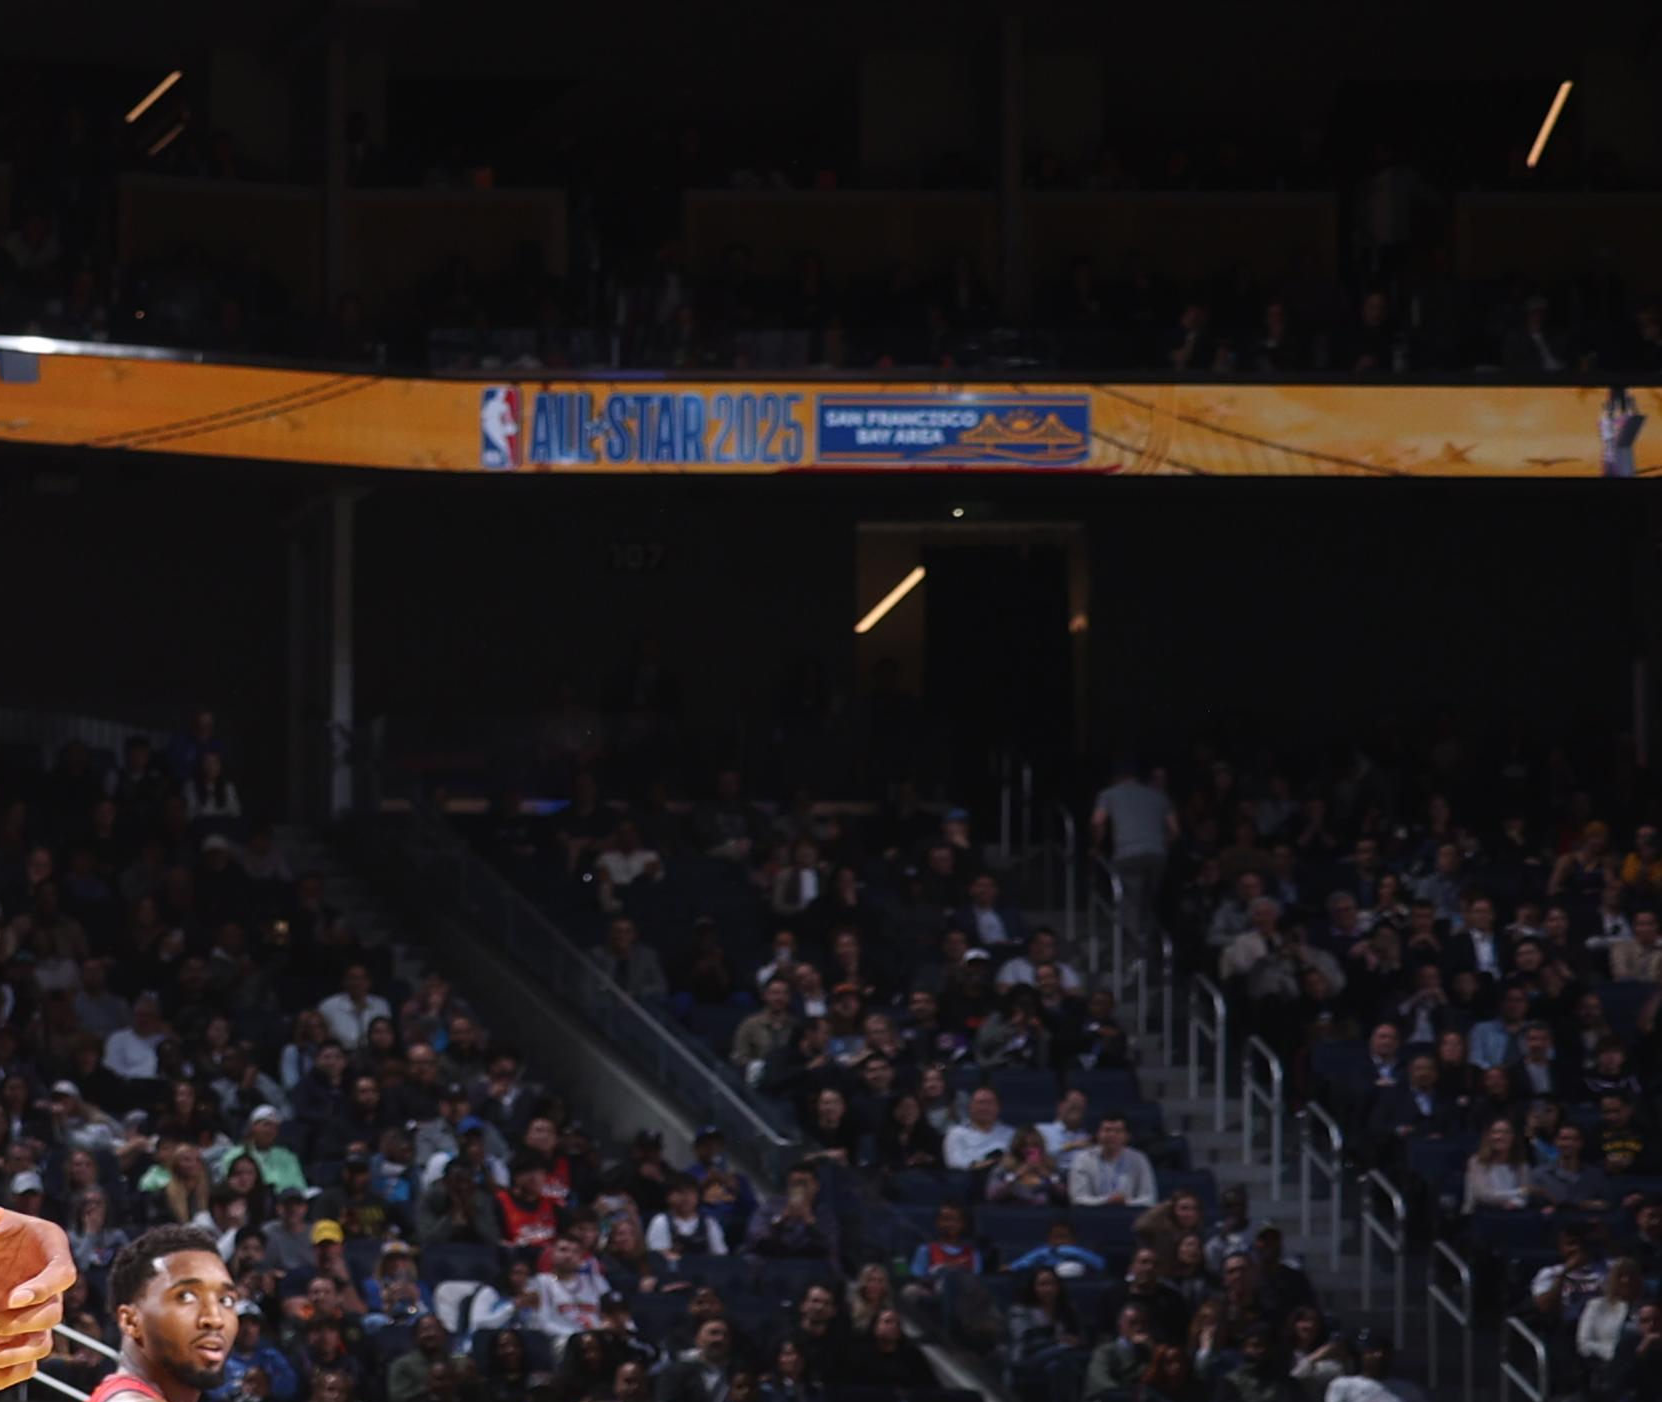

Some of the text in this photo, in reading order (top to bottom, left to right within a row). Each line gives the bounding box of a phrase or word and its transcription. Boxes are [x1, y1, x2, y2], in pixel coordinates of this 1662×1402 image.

[711, 392, 806, 465] 2025
[825, 410, 979, 429] SAN FRANCISCO
[856, 428, 945, 446] BAY AREA
